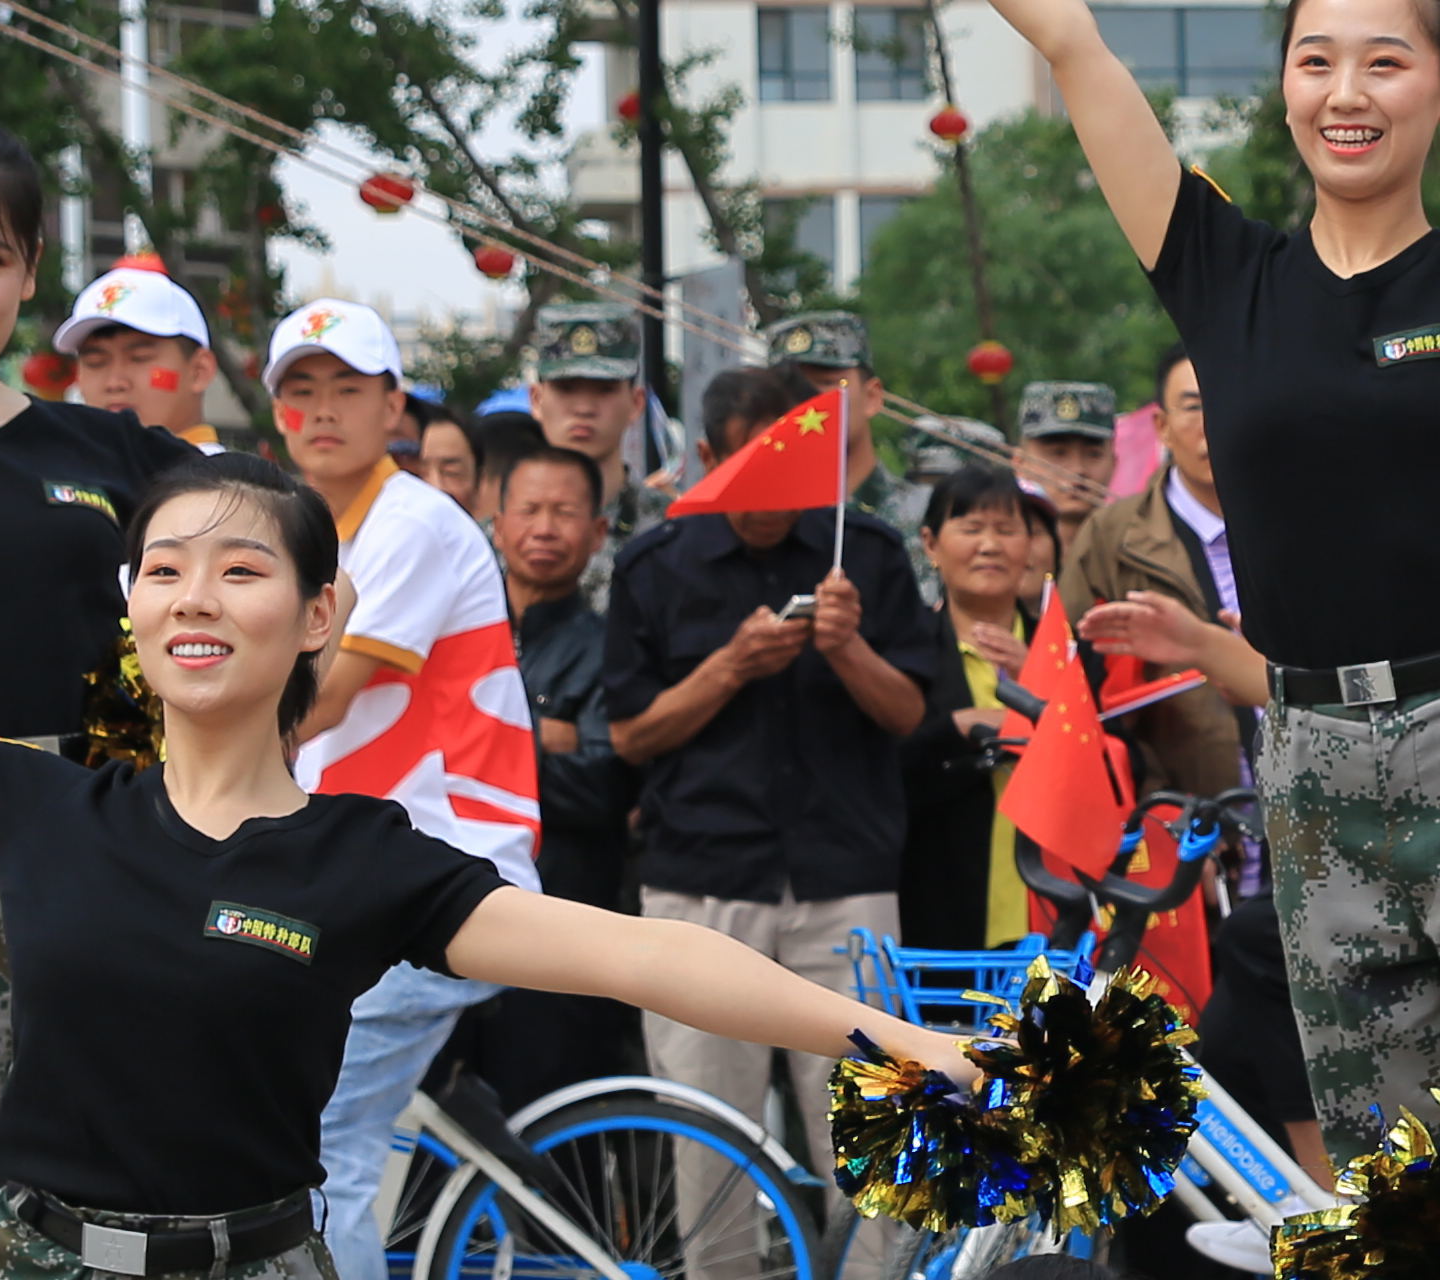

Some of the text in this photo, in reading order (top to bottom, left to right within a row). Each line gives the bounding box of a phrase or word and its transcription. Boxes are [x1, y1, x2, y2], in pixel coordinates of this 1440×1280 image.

[242, 917, 312, 955] 中国特种部队
